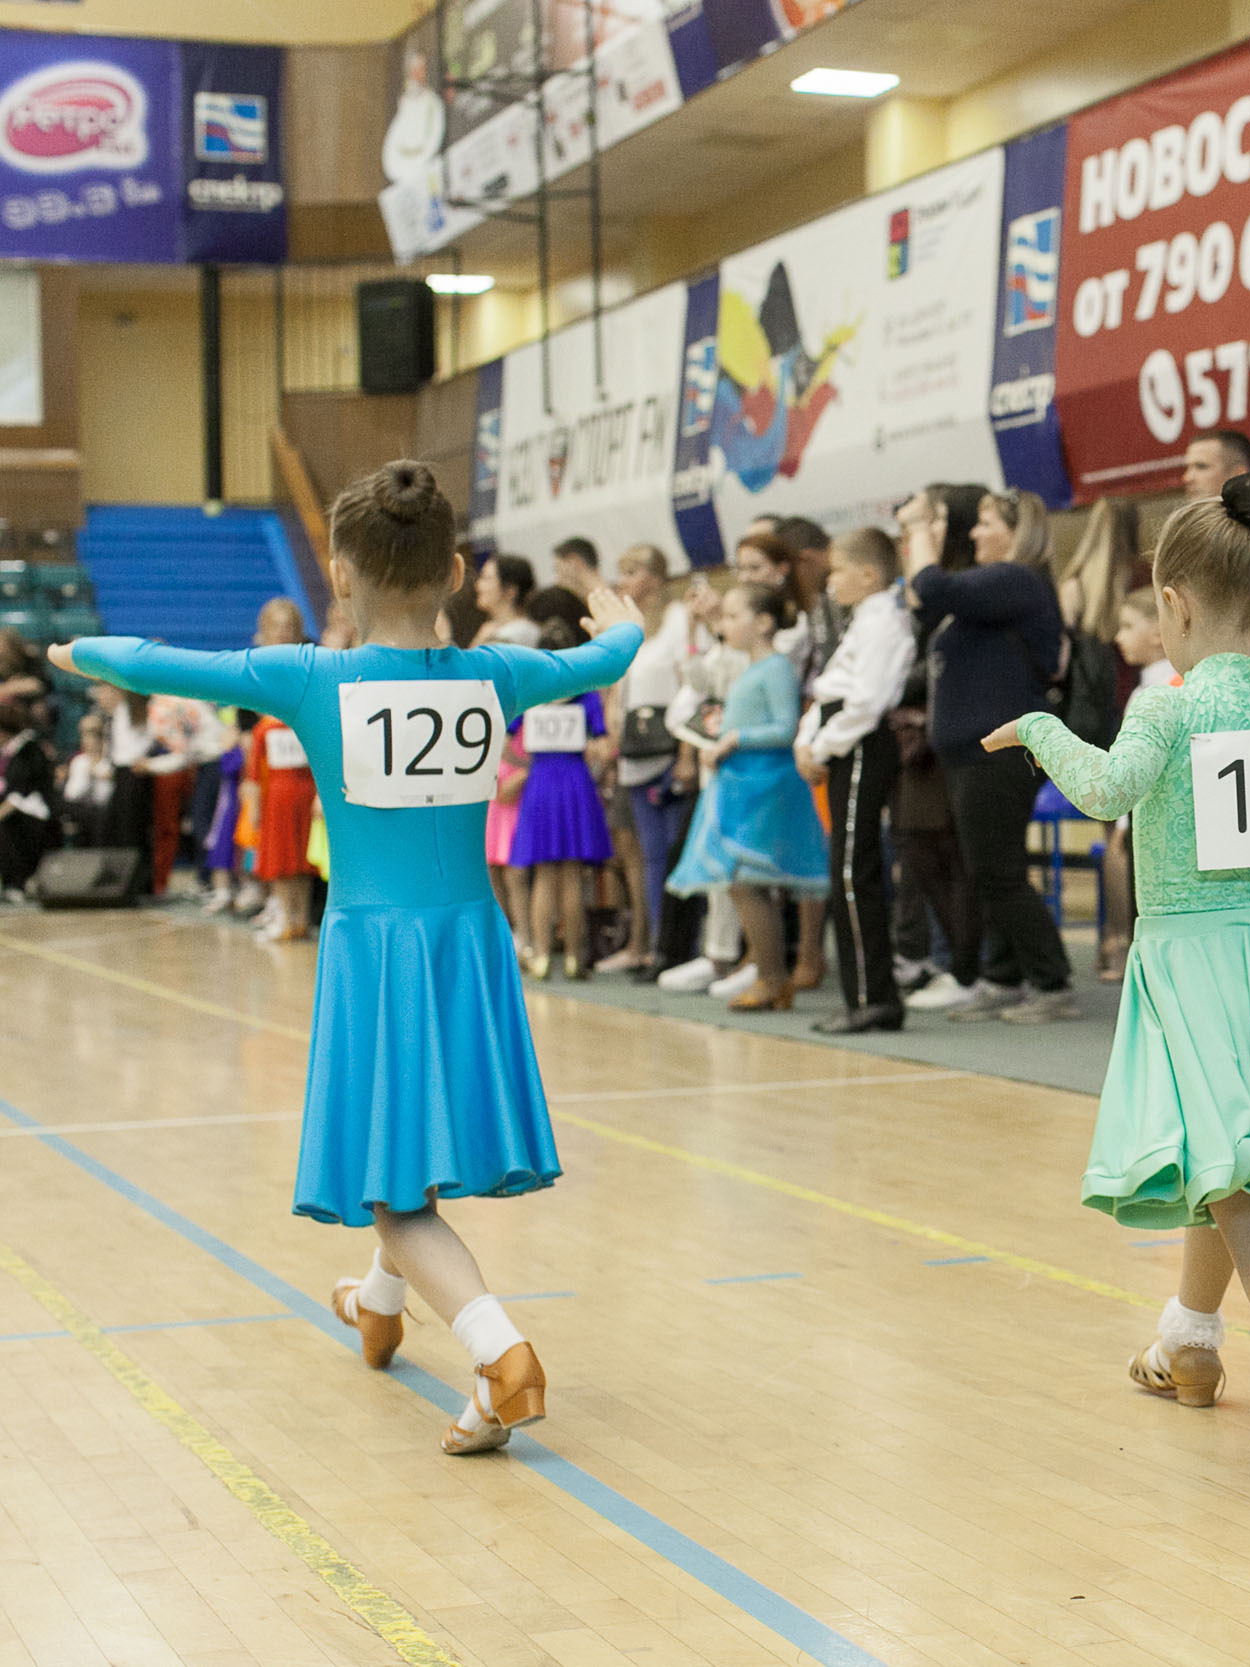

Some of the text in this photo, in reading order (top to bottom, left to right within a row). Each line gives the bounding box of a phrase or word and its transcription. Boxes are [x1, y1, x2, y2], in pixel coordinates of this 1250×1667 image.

[1073, 269, 1130, 337] от
[1134, 221, 1235, 321] 790
[366, 706, 492, 777] 129
